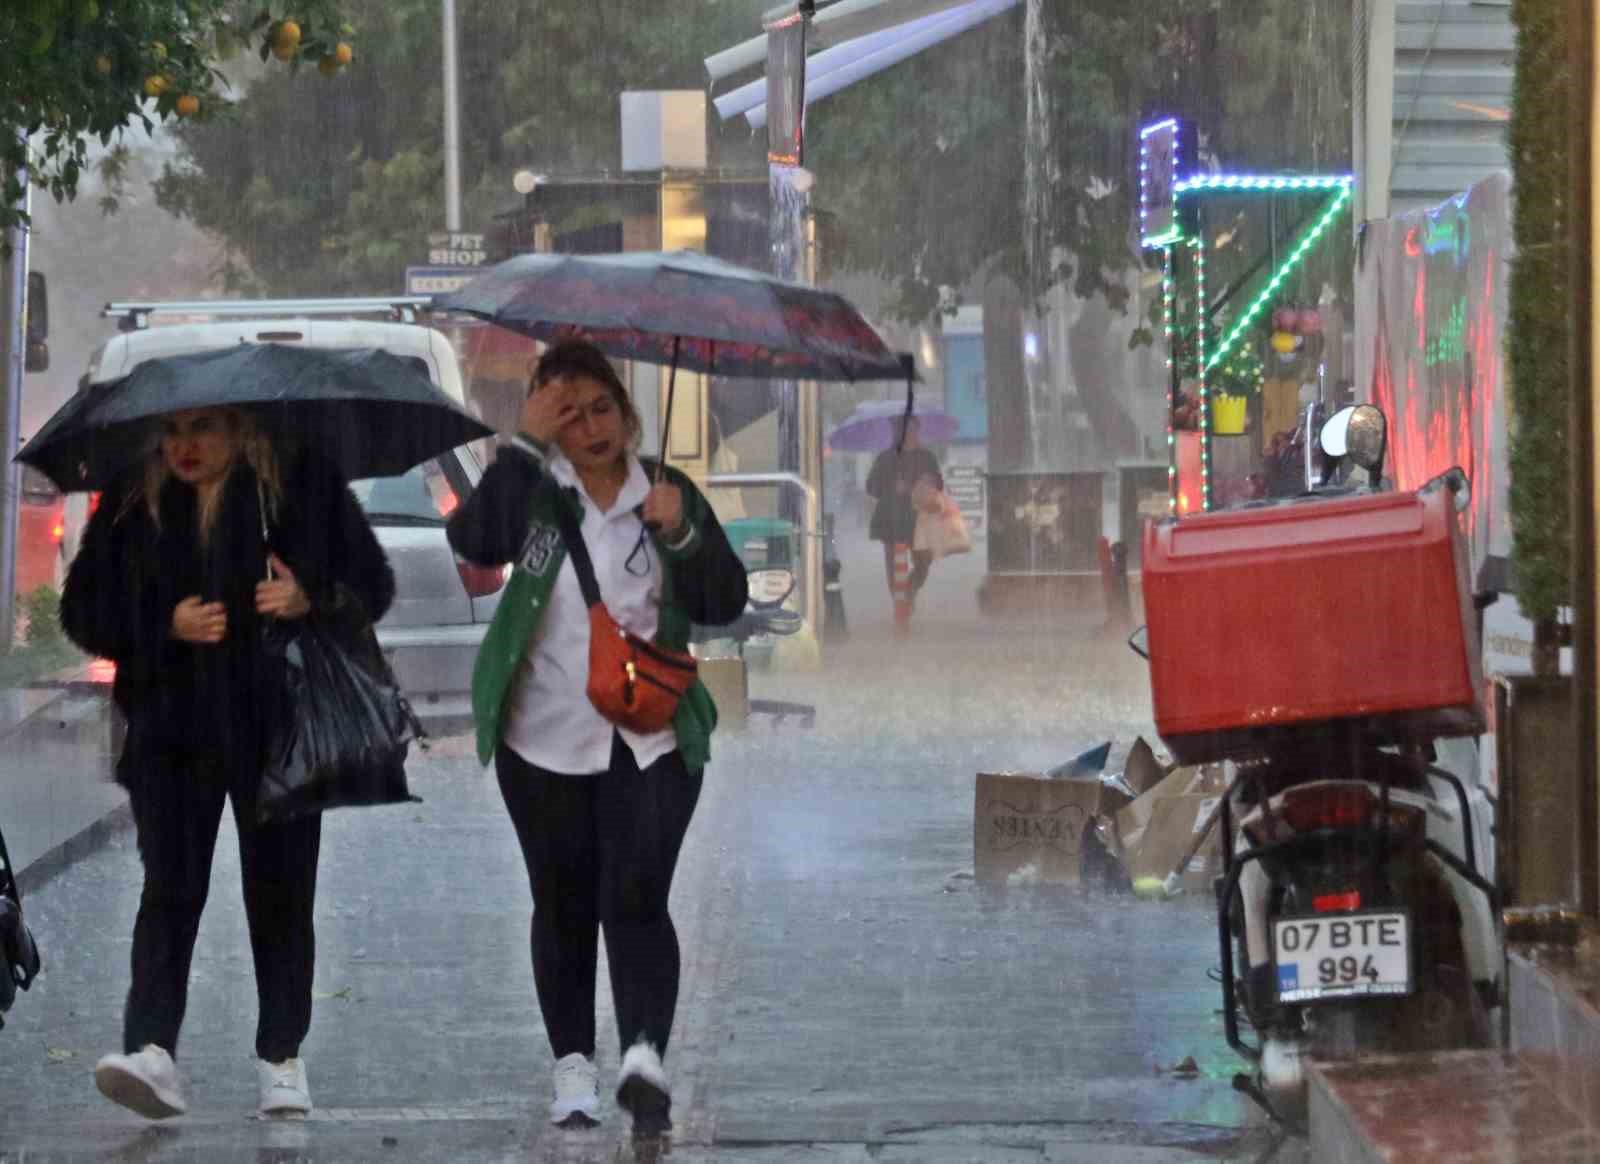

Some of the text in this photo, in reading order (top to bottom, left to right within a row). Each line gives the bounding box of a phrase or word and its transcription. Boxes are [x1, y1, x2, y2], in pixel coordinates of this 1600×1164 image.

[450, 234, 484, 249] PET
[429, 250, 487, 266] SHOP
[1281, 918, 1401, 952] 07 BTE
[1318, 954, 1379, 984] 994
